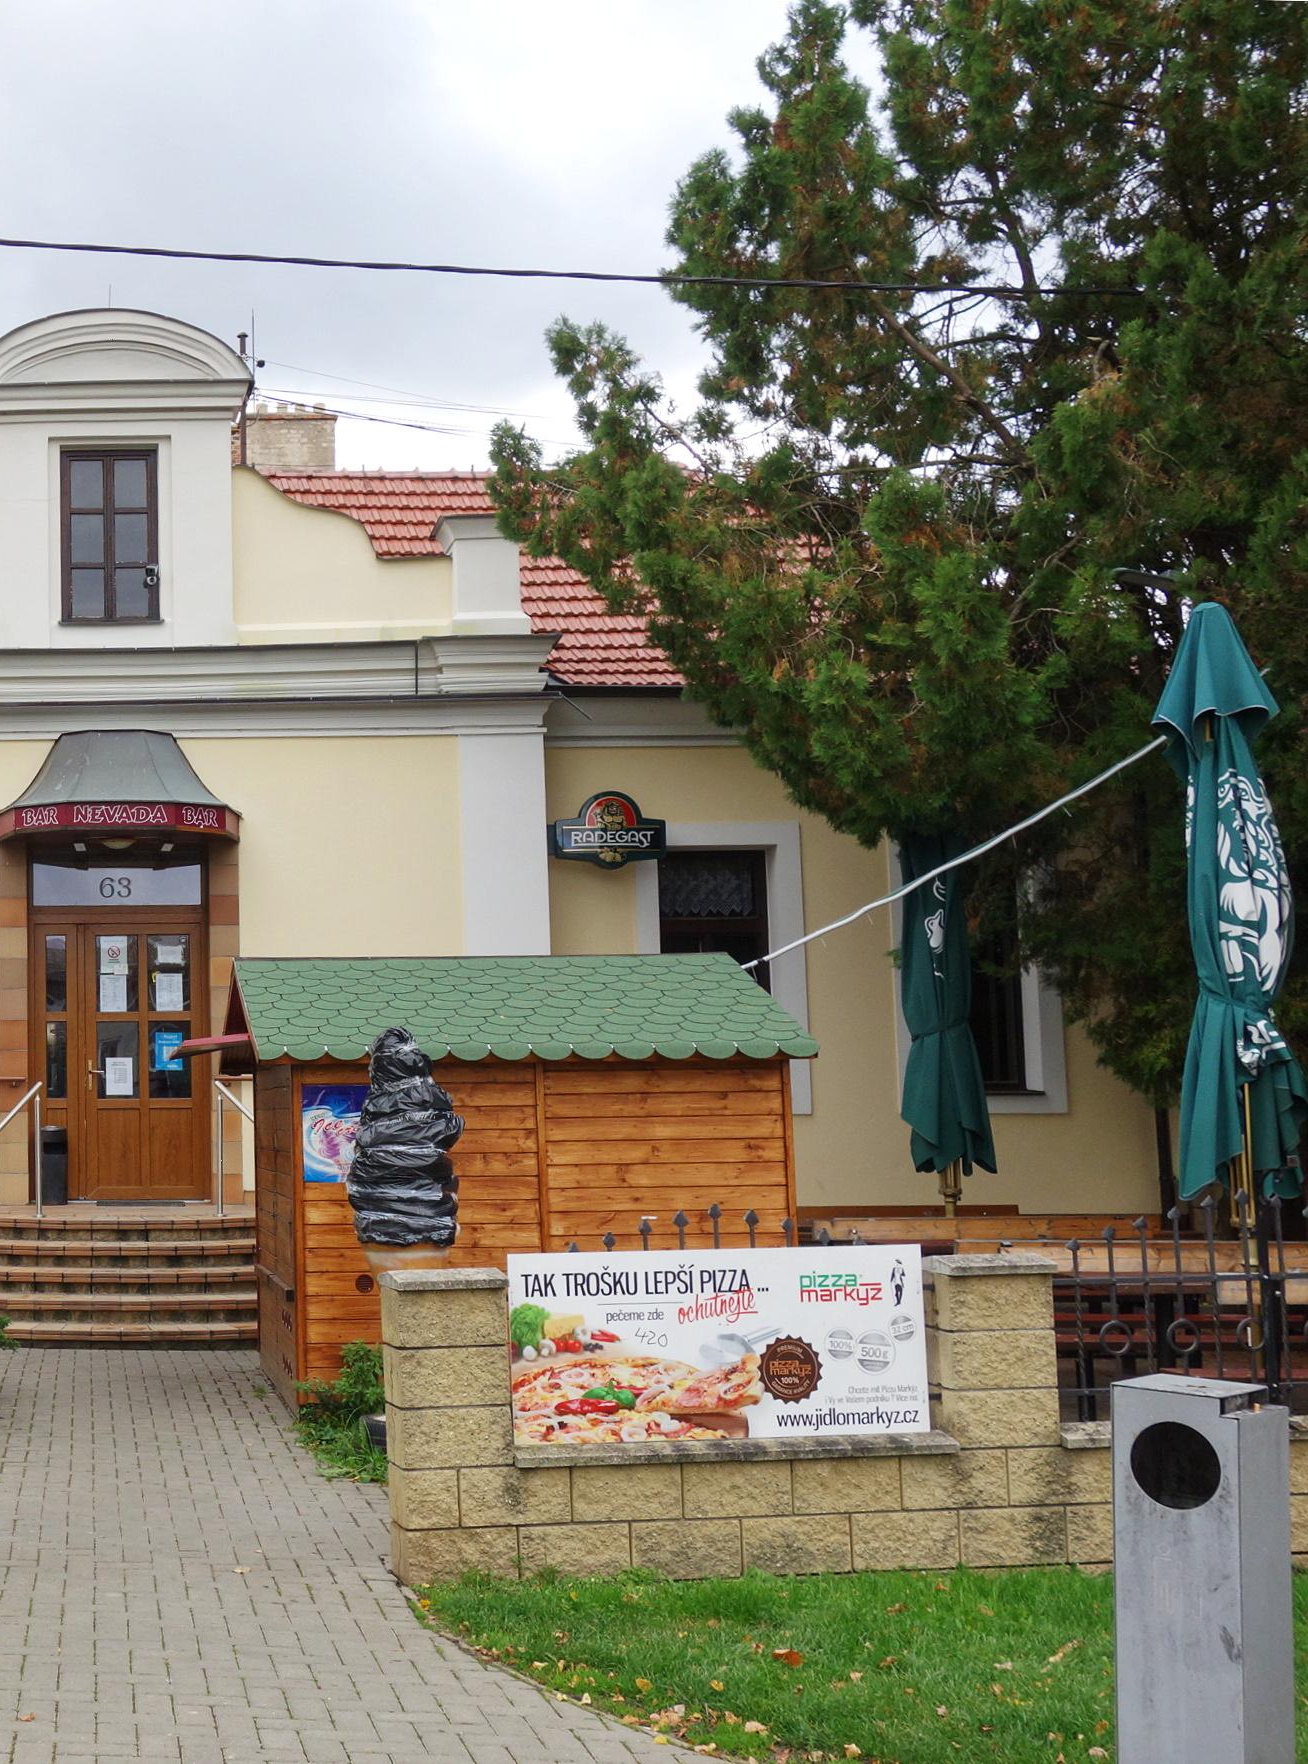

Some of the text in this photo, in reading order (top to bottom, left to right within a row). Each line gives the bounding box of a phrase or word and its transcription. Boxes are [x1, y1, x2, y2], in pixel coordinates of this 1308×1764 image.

[22, 804, 219, 828] BAR NEVADA BAR
[571, 831, 655, 848] RADEGAST
[99, 876, 132, 898] 63
[521, 1273, 557, 1298] TAK
[562, 1266, 638, 1296] TROŠKU
[644, 1264, 694, 1295] LEPŠÍ
[699, 1269, 751, 1294] PIZZA
[799, 1270, 857, 1289] pizza
[677, 1287, 759, 1324] ochutnejte
[605, 1308, 664, 1324] pečeme zde
[634, 1326, 668, 1347] 420
[829, 1340, 852, 1350] 100%
[861, 1347, 882, 1358] 500
[769, 1359, 799, 1368] pizza
[781, 1376, 800, 1384] 100%
[776, 1406, 919, 1431] www.jidlomarkyz.cz
